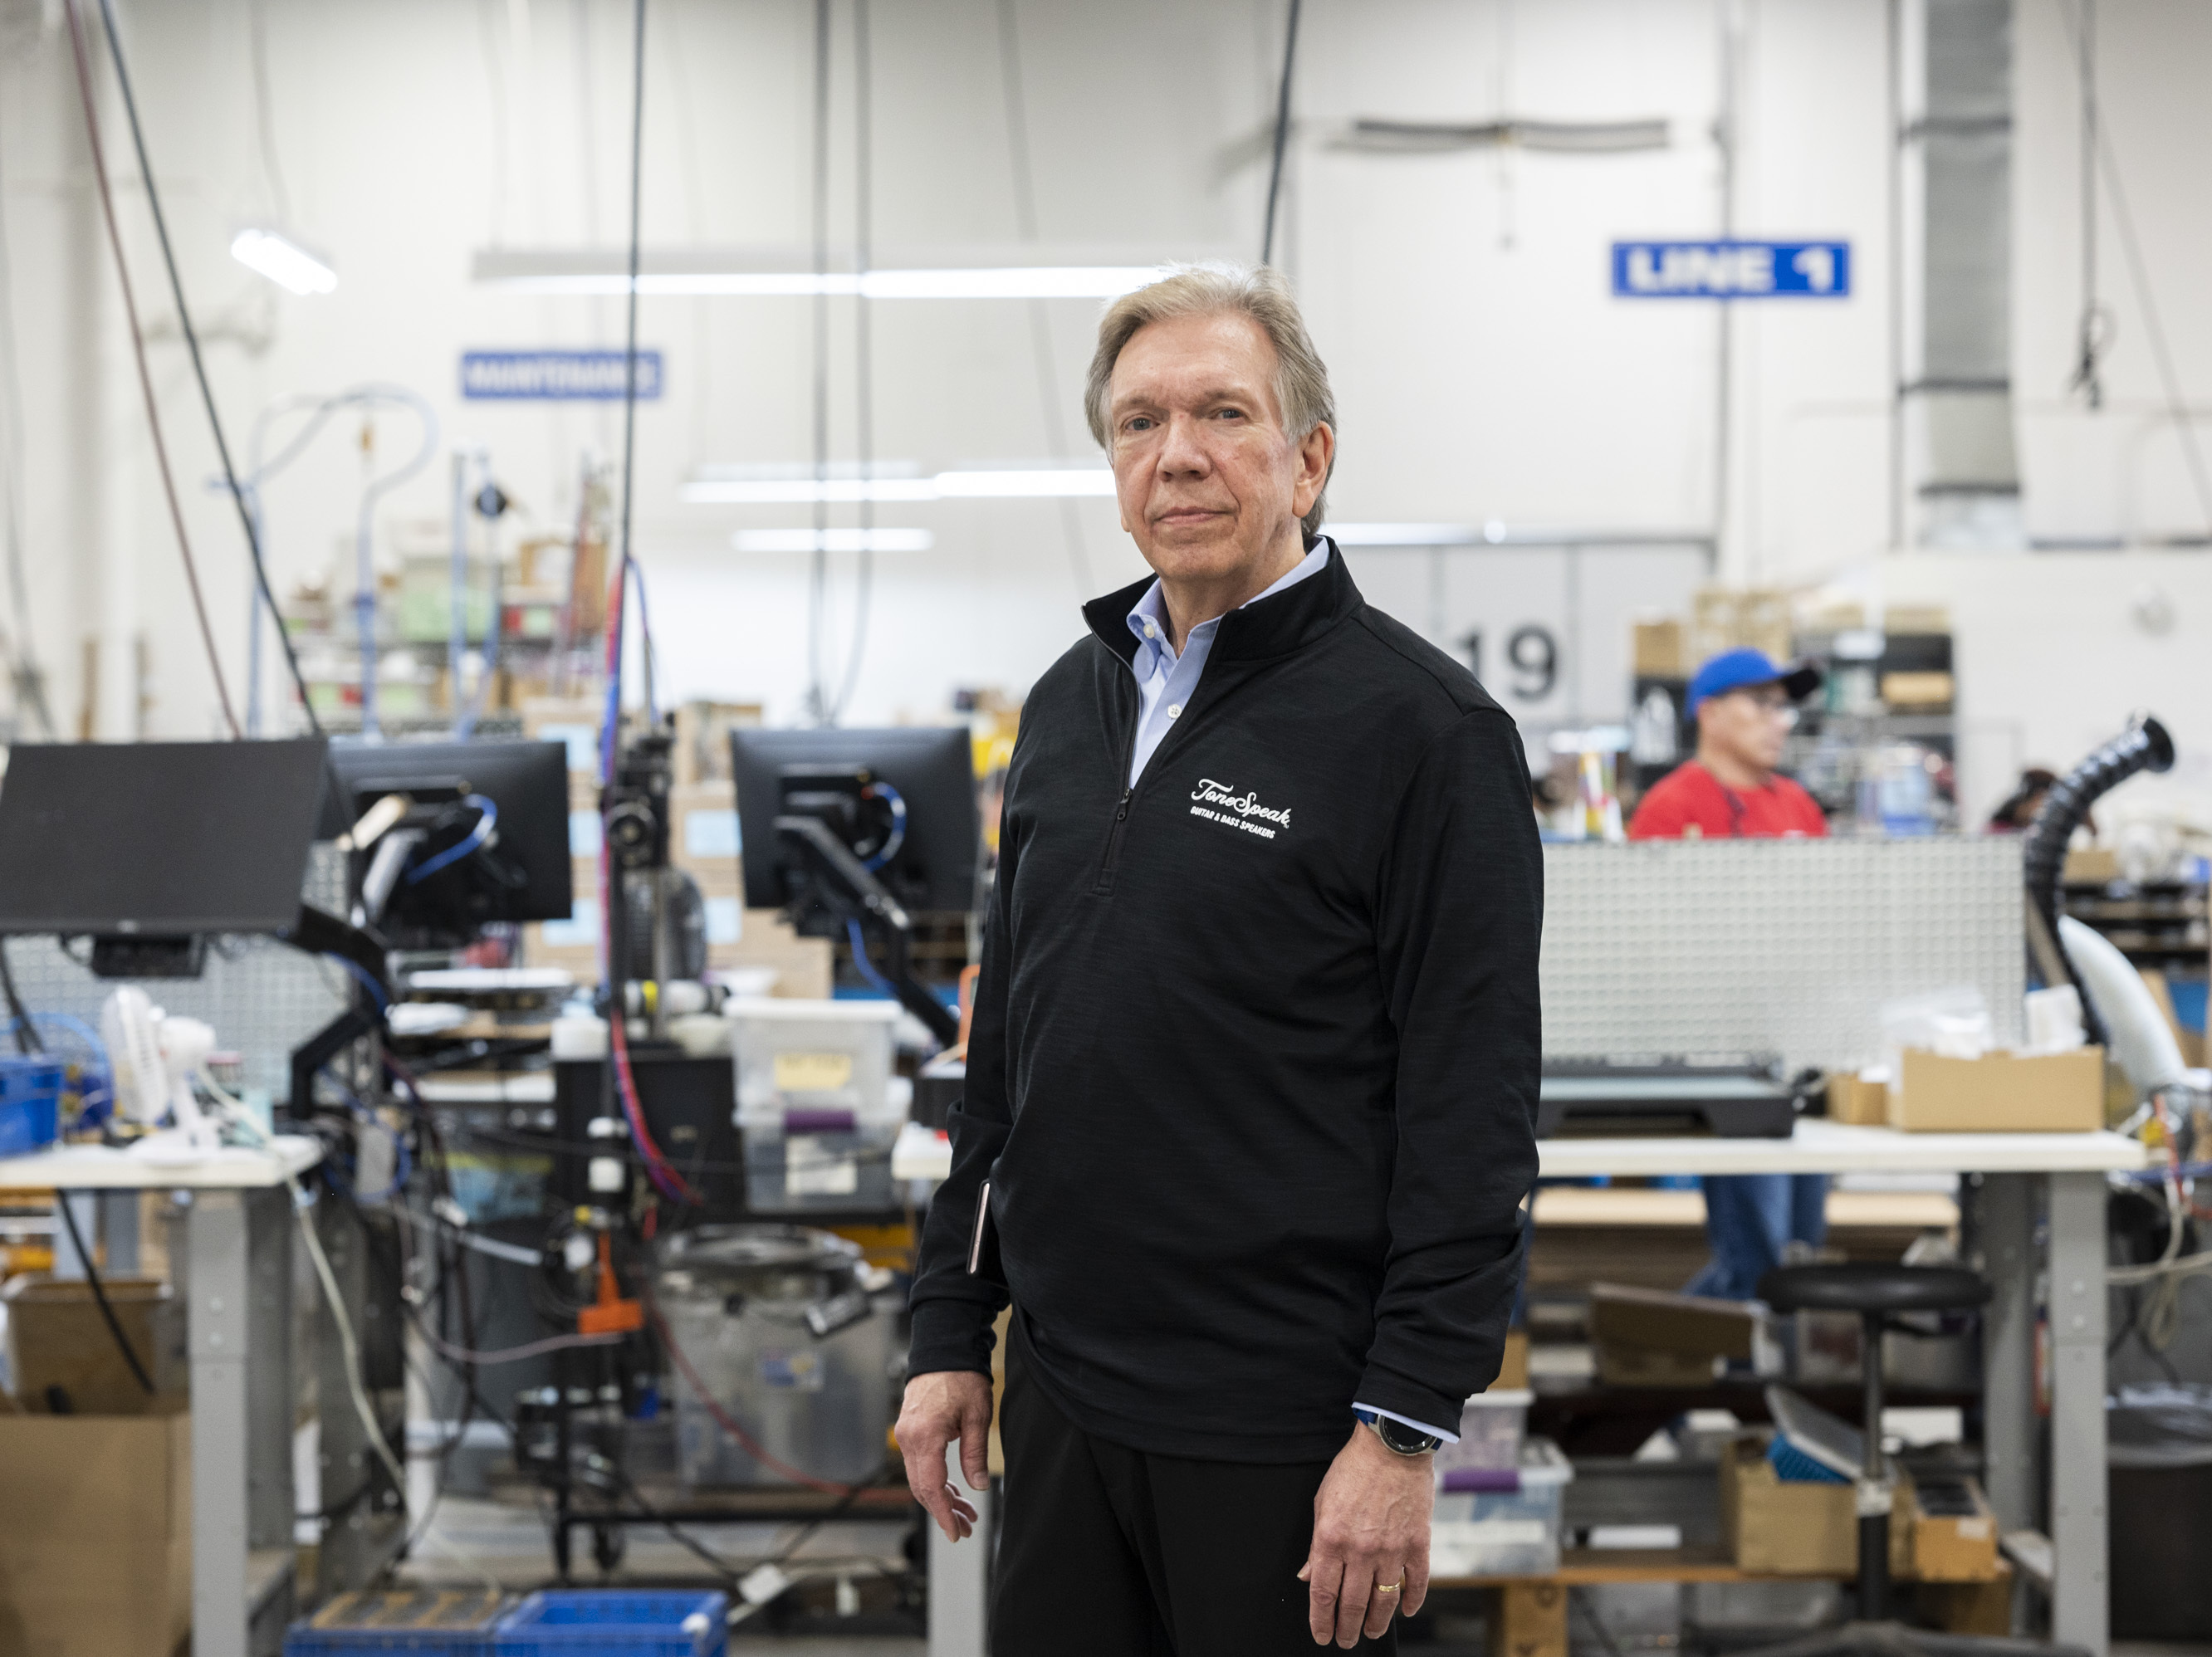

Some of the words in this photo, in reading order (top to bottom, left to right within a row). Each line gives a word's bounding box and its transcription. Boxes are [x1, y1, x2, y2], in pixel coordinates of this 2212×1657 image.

[1629, 247, 1774, 291] LINE
[1792, 246, 1833, 291] 1
[1455, 623, 1557, 702] 19
[1190, 805, 1214, 820] GUITAR
[1213, 812, 1221, 821] &
[1220, 814, 1241, 828] BASS
[1239, 820, 1276, 839] SPEAKERS
[1191, 778, 1292, 827] ToneSpeak
